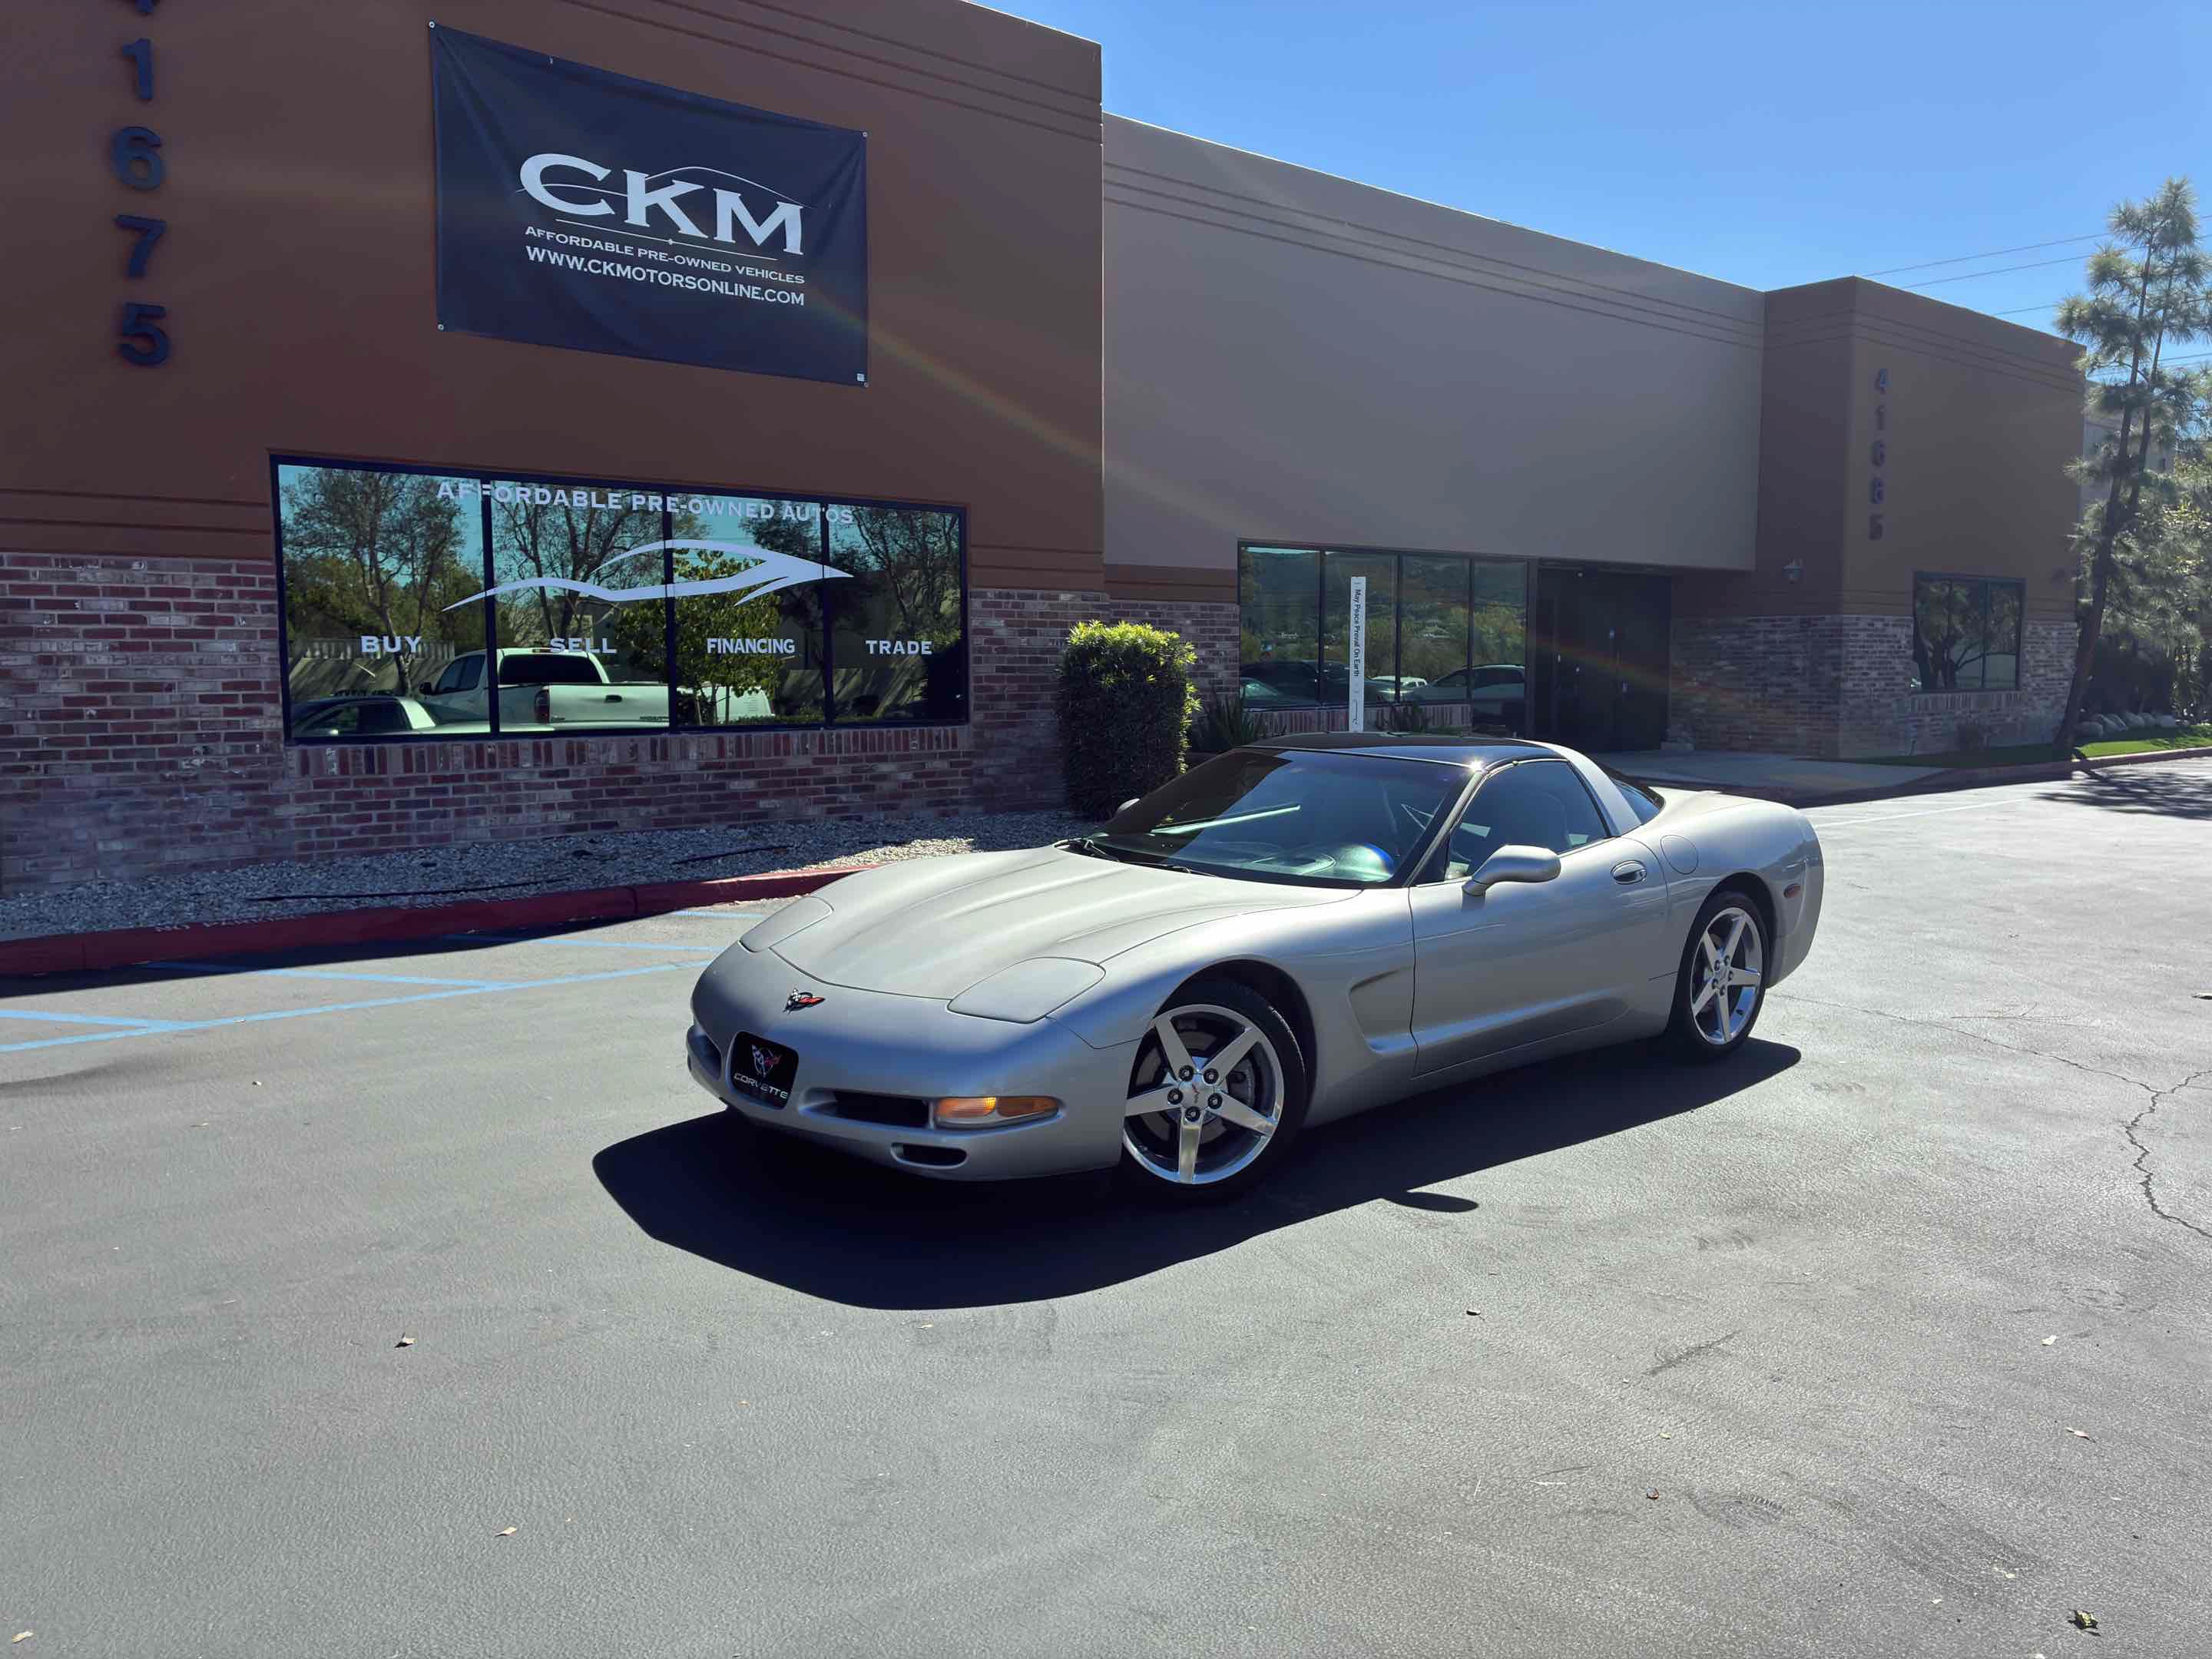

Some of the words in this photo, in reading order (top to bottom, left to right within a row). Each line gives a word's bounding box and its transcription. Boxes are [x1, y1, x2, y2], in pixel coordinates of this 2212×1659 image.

[111, 0, 171, 367] 1675
[520, 153, 804, 255] CKM
[525, 226, 634, 256] AFFORDABLE
[637, 247, 732, 273] PRE-OWNED
[734, 265, 805, 284] VEHICLES
[525, 245, 805, 306] WWW.CKMOTORSONLINE.COM
[436, 482, 622, 510] AFFORDABLE
[631, 494, 776, 519] PRE-OWNED
[781, 505, 854, 524] AUTOS
[1353, 589, 1362, 603] May
[360, 635, 422, 654] BUY
[549, 637, 617, 654] SELL
[706, 638, 796, 654] FINANCING
[866, 640, 932, 654] TRADE
[1353, 659, 1361, 677] Earth
[733, 1072, 789, 1099] CORVETTE
